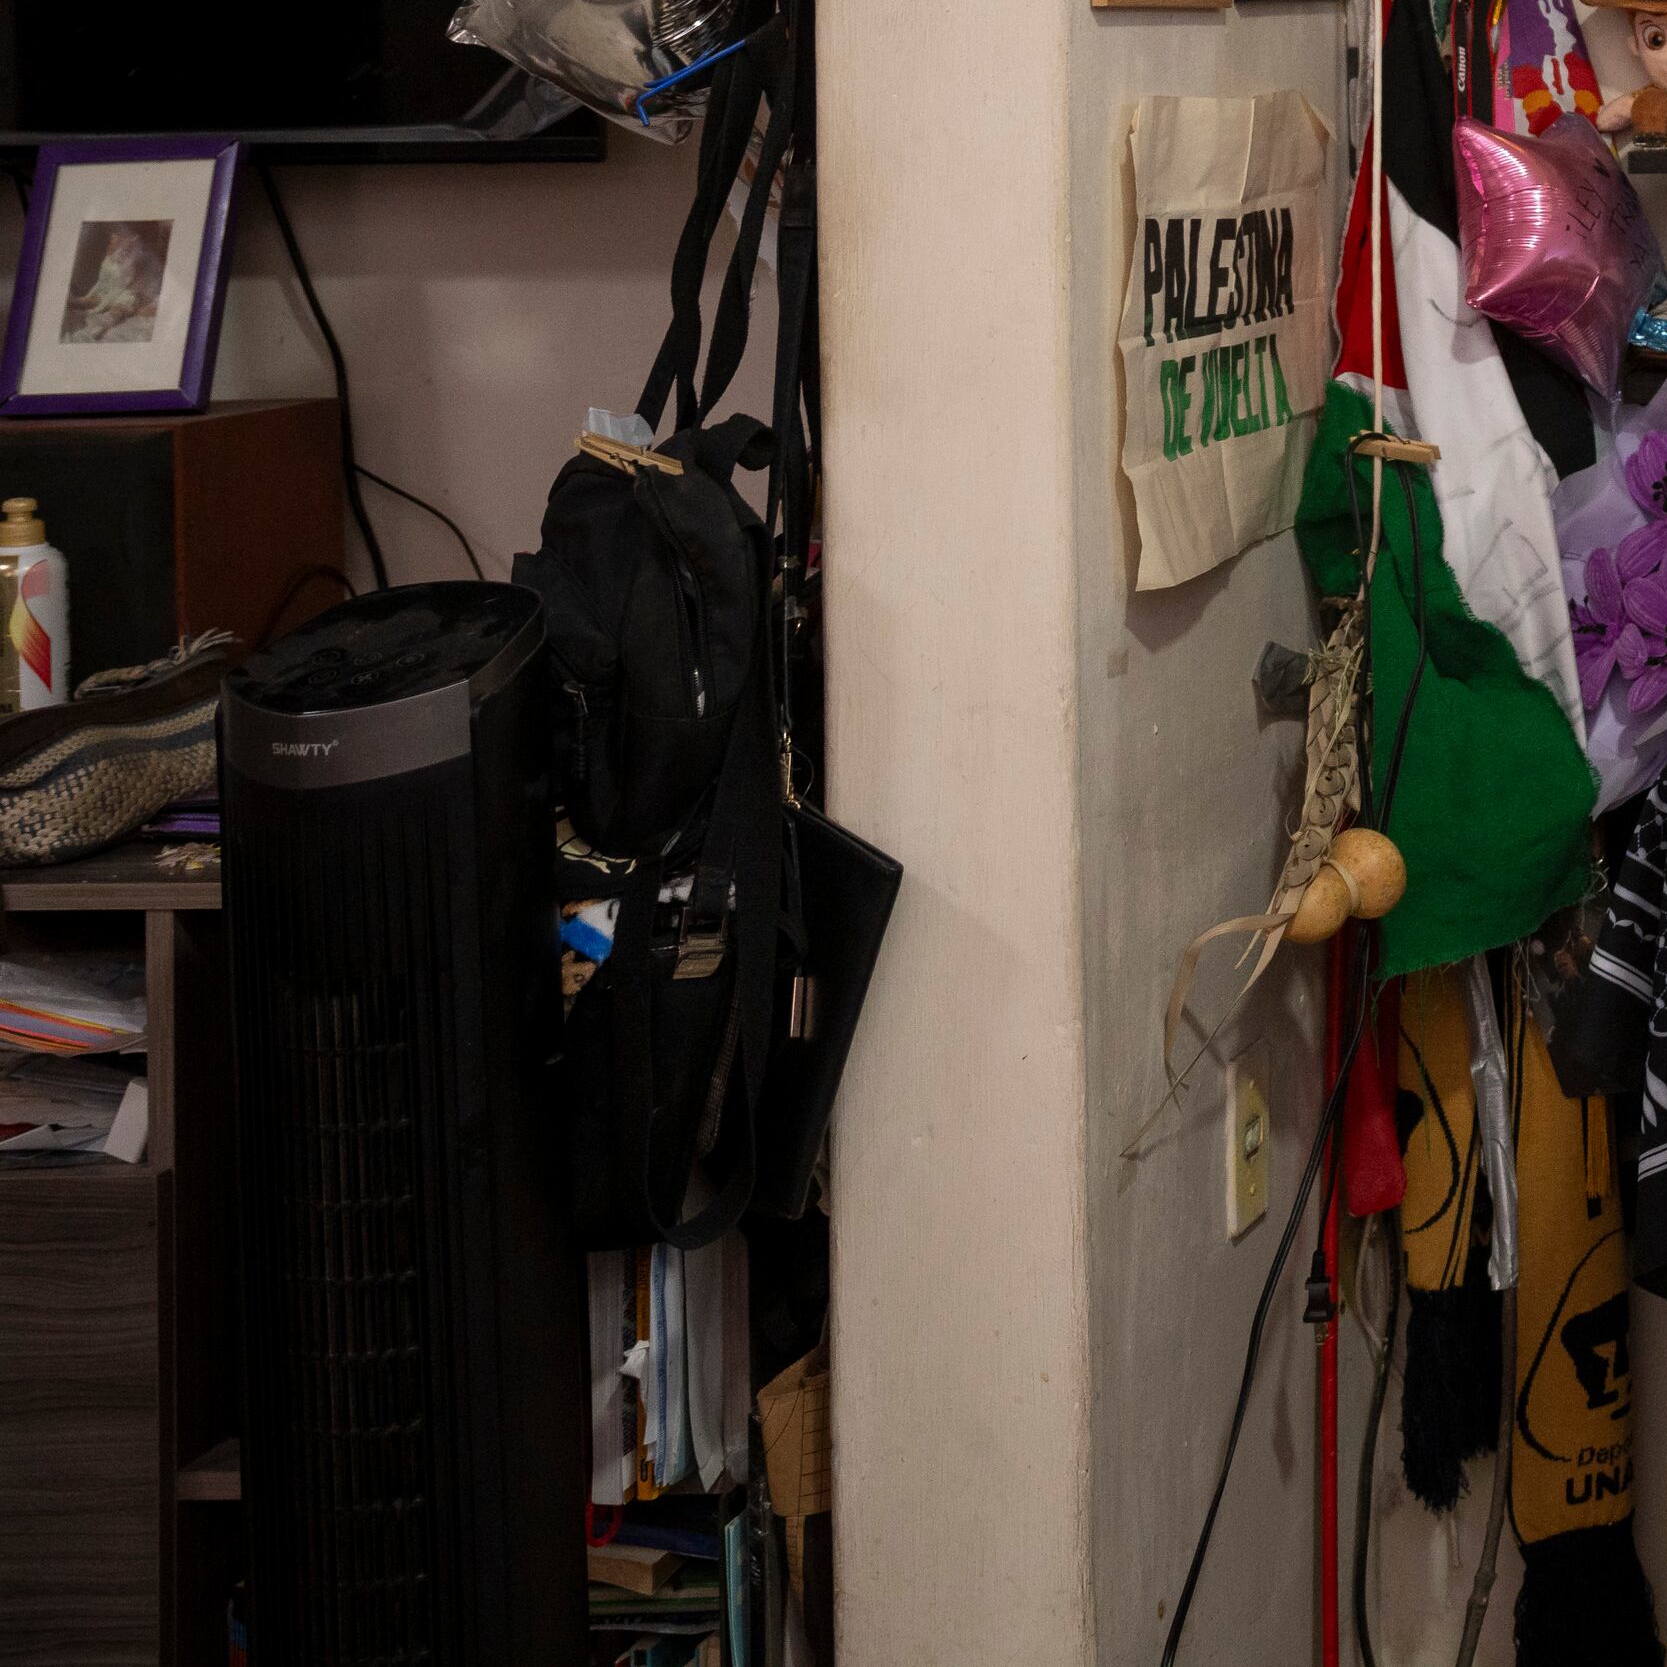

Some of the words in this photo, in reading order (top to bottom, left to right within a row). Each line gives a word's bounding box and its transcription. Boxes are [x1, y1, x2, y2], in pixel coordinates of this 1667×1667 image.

[1457, 46, 1467, 92] Canon
[1144, 207, 1294, 348] PALESTINA
[1160, 356, 1195, 463] DE
[1200, 334, 1294, 448] VUELTA
